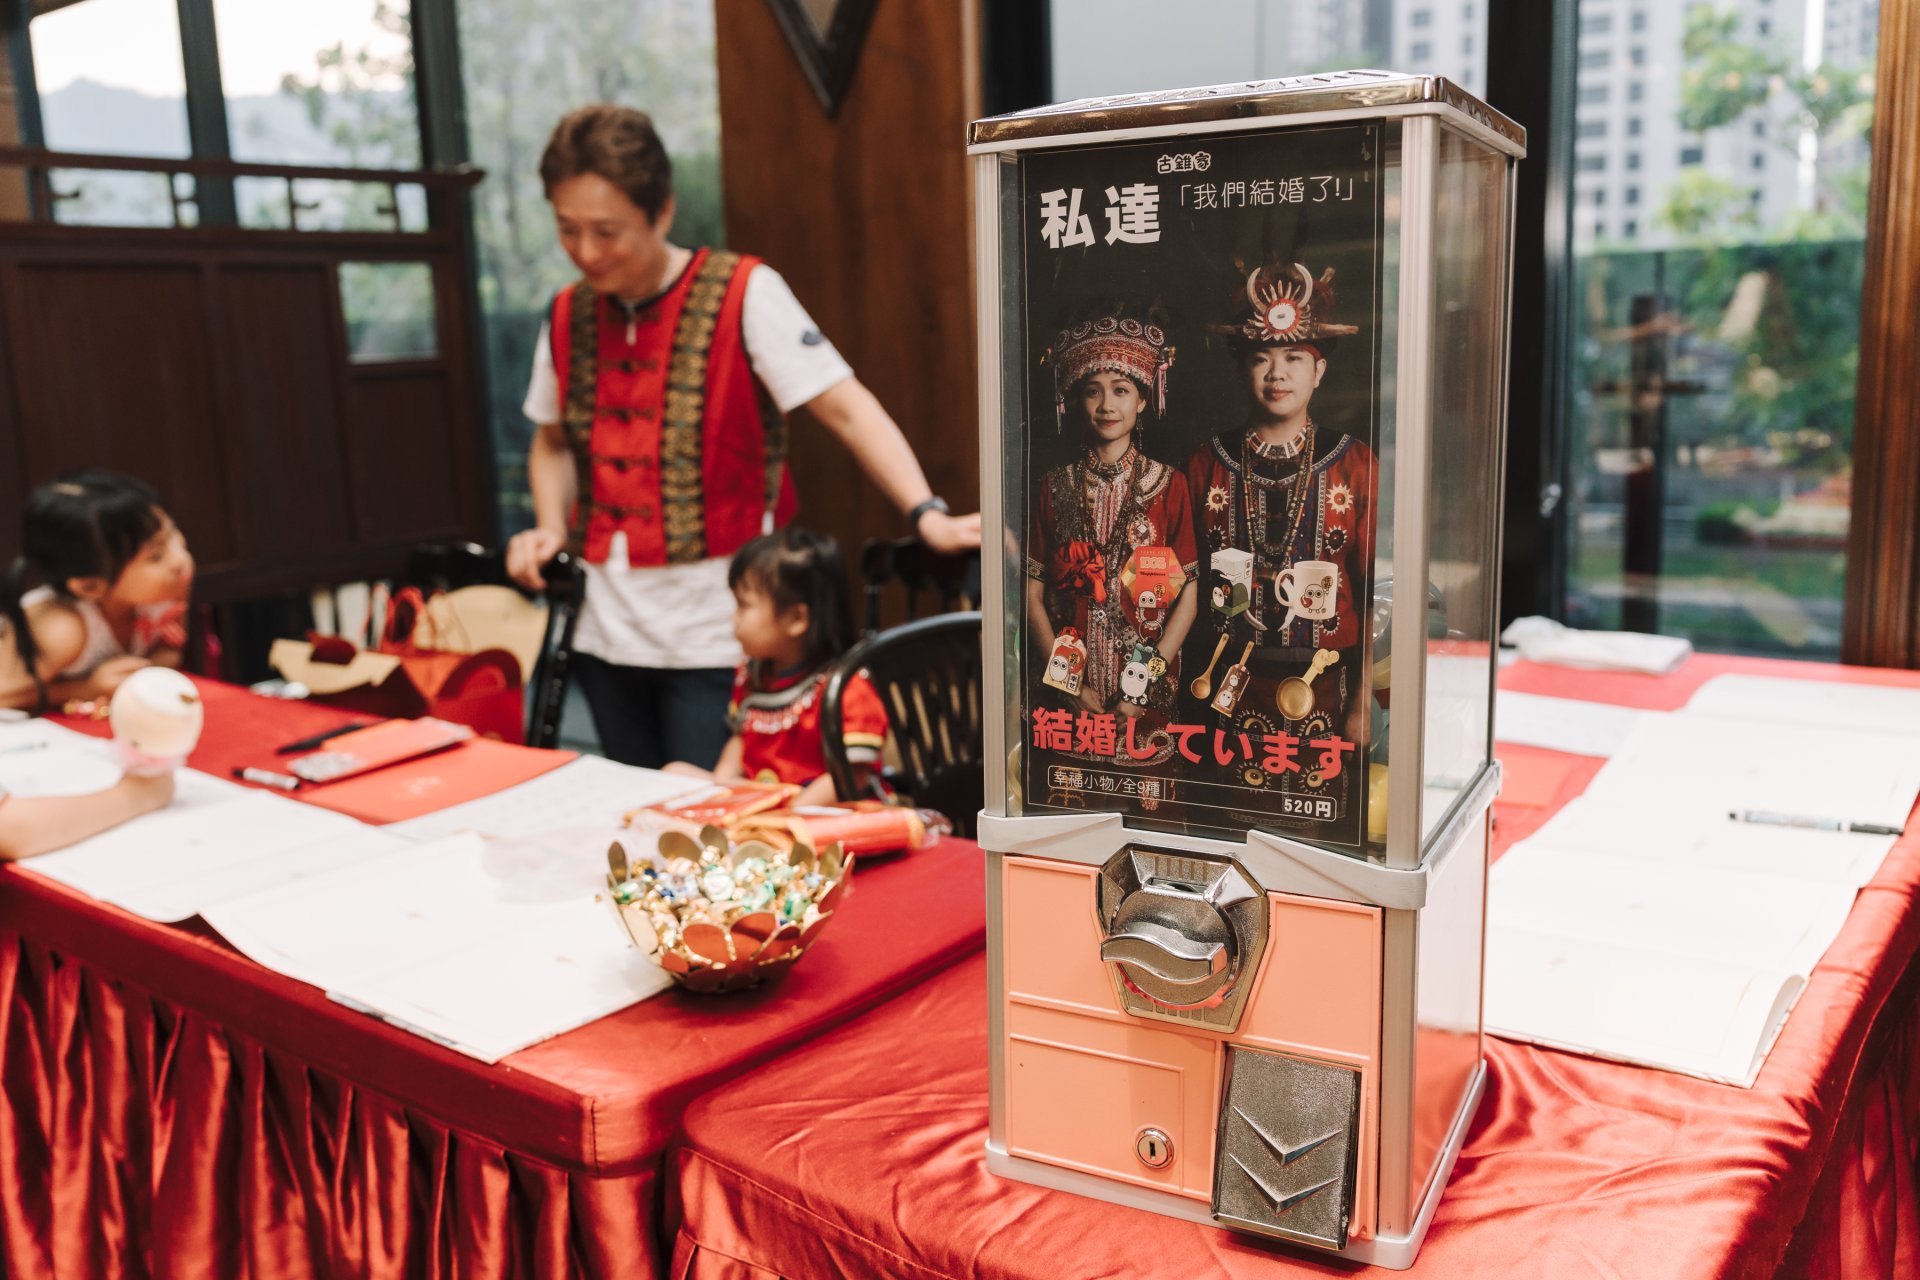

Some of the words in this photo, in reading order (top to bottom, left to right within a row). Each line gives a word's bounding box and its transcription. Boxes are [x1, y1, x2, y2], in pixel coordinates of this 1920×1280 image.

[1157, 151, 1211, 174] 古錐家
[1040, 183, 1161, 249] 私達
[1032, 706, 1355, 780] 結婚しています
[1053, 770, 1161, 797] 幸福小物/全9種
[1284, 798, 1331, 818] 520円
